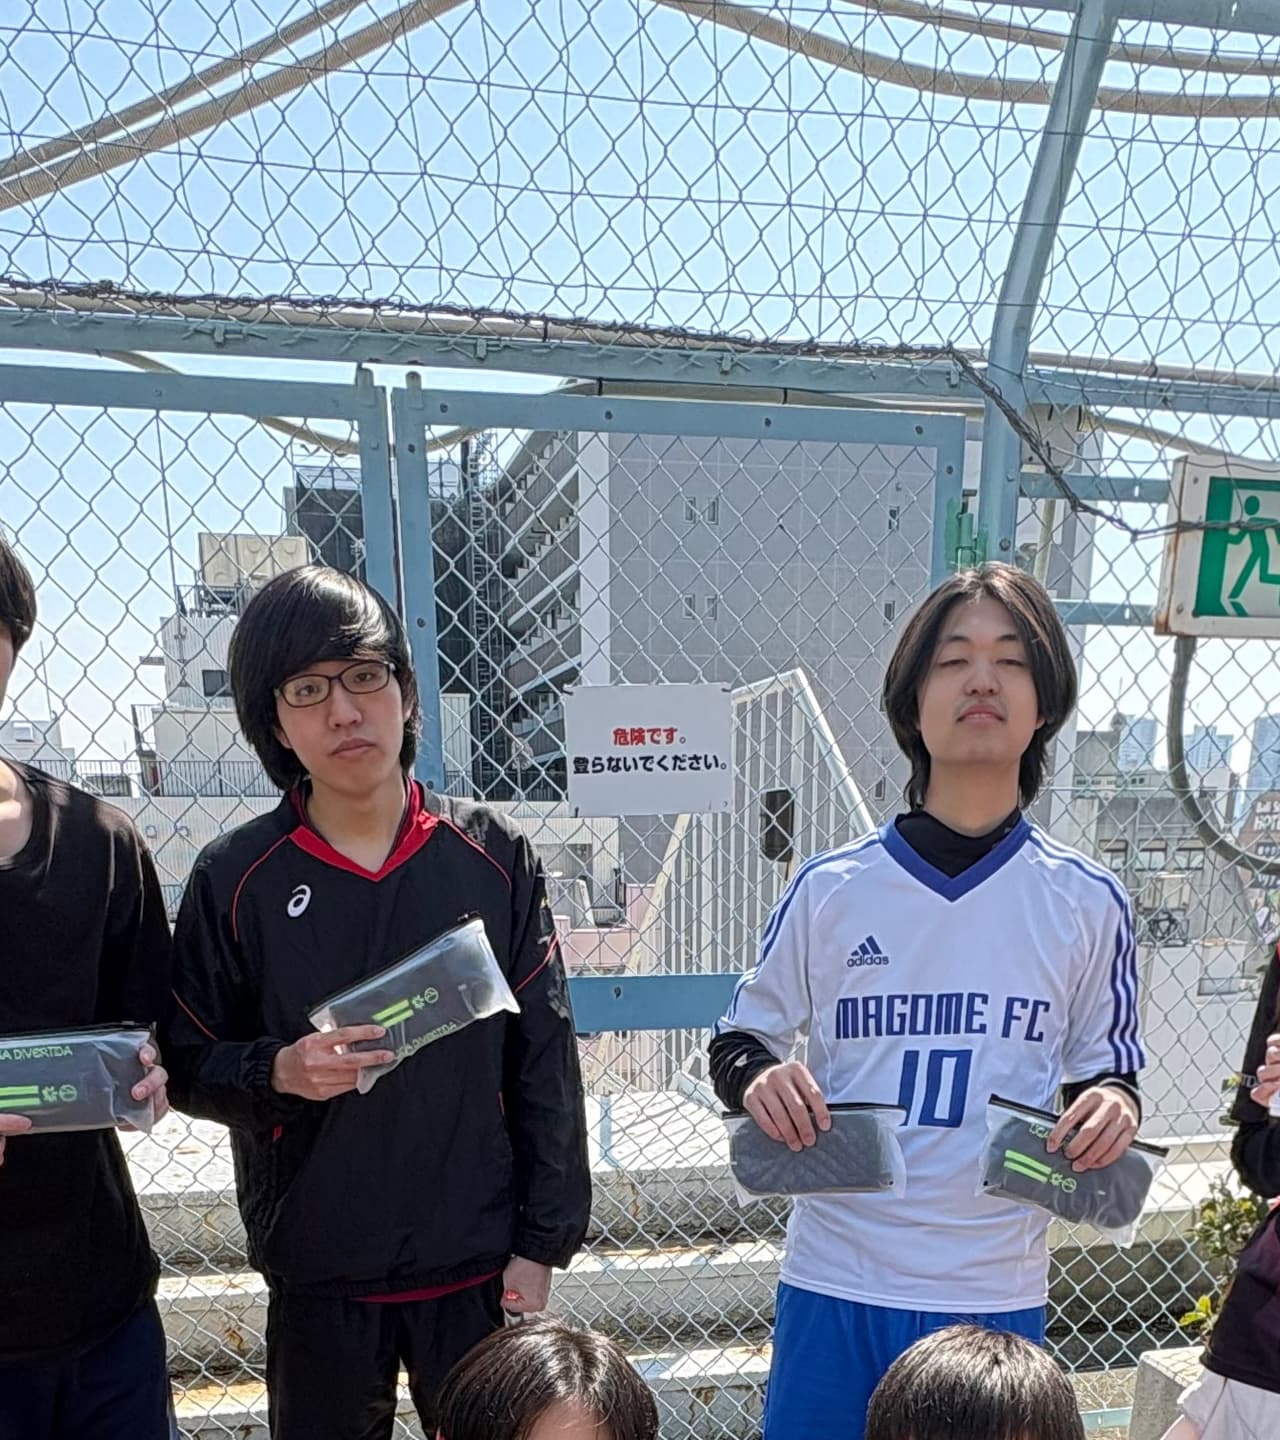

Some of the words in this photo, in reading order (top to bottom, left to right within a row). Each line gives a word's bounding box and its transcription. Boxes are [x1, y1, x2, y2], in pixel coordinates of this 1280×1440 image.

[612, 727, 687, 746] 危険です。
[572, 754, 728, 775] 登らないでください。
[846, 954, 890, 968] adidas
[835, 992, 989, 1040] MAGOME
[1001, 996, 1051, 1043] FC
[898, 1048, 973, 1128] 10
